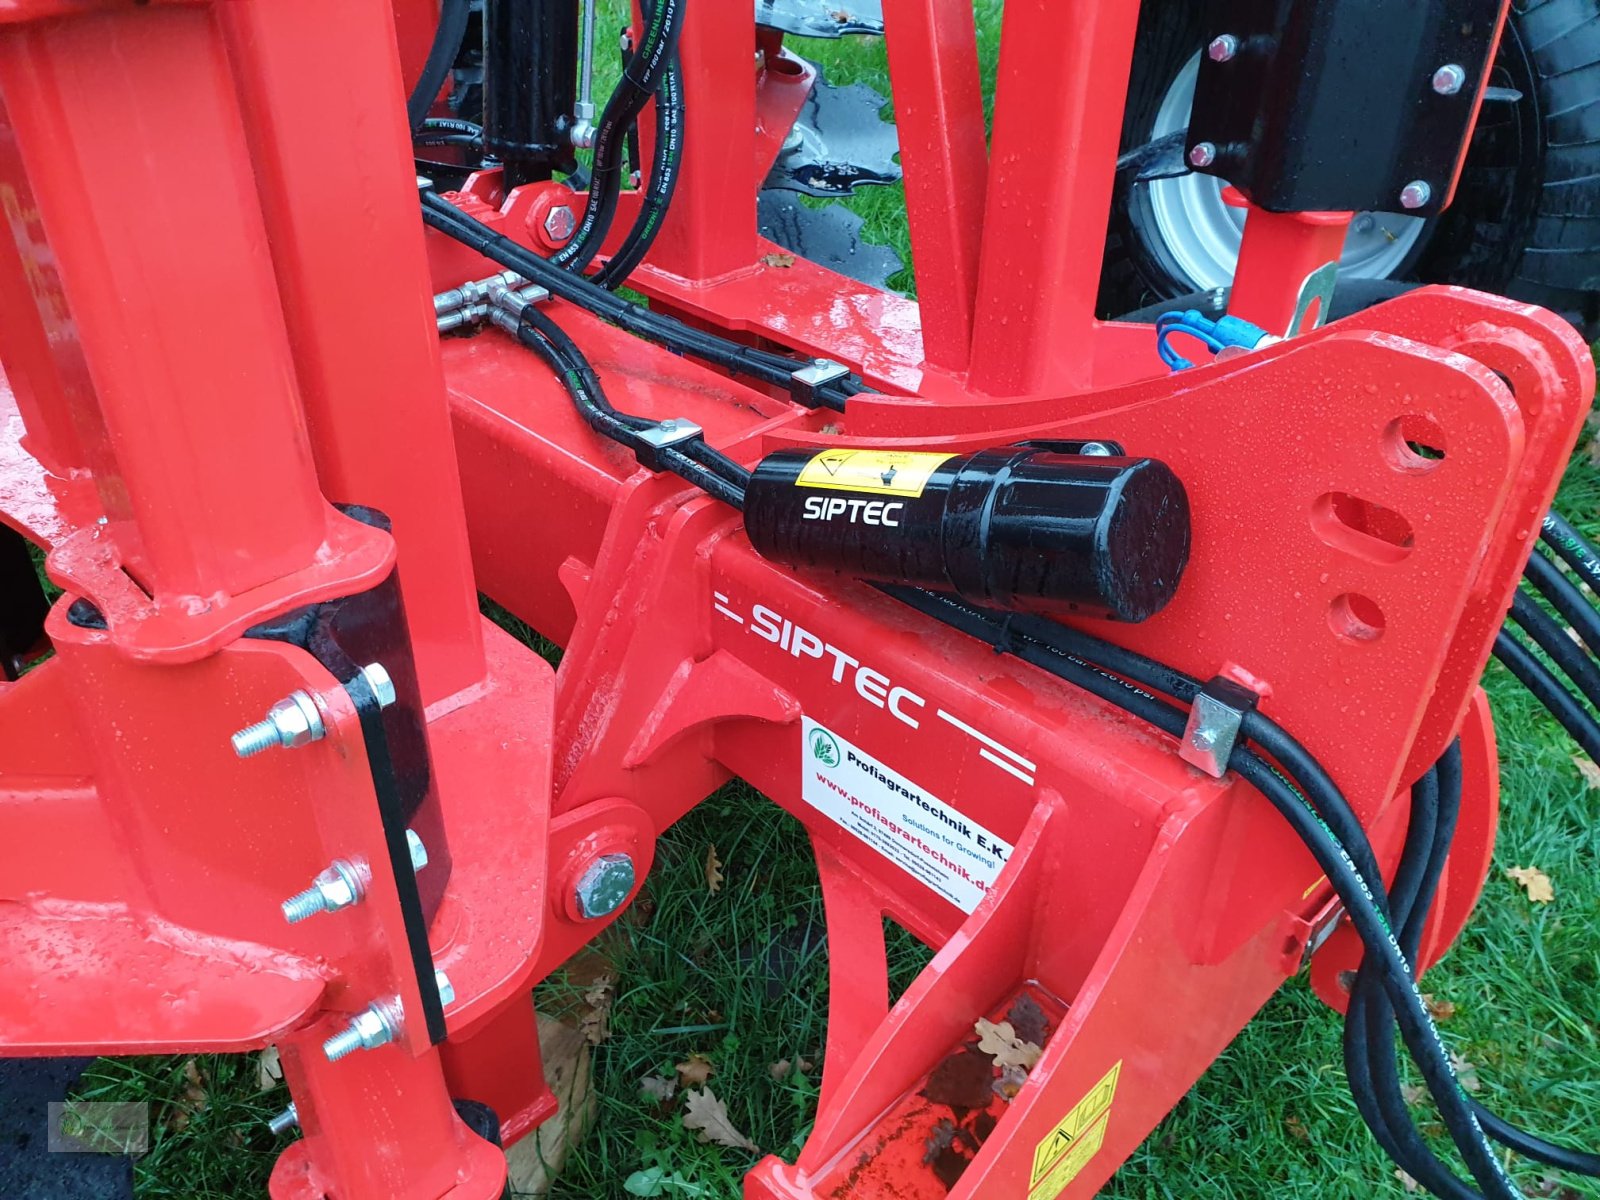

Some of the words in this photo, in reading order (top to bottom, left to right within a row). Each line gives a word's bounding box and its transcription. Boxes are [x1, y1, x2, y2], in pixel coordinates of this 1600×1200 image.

[803, 496, 904, 527] SIPTEC
[751, 604, 926, 730] SIPTEC
[847, 750, 971, 840] Profiagrartechnik
[977, 833, 1008, 863] E.K.
[902, 813, 940, 840] Solutions
[942, 834, 954, 847] for
[956, 842, 996, 869] Growing!
